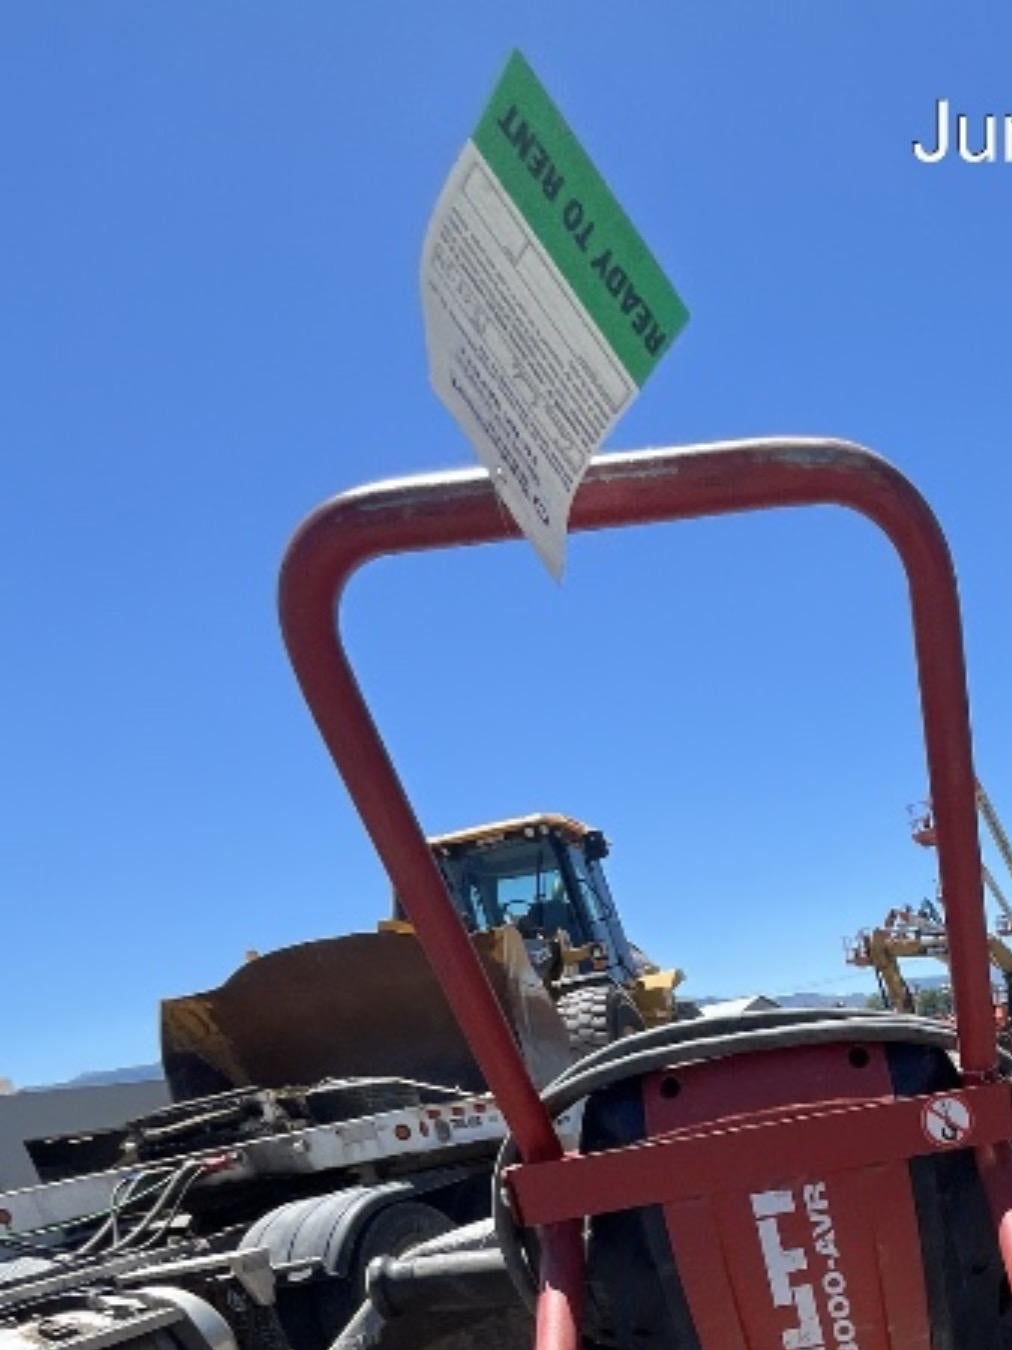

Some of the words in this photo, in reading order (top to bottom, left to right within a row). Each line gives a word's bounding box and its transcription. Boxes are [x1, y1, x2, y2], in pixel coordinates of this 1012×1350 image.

[497, 104, 565, 202] RENT
[563, 199, 595, 252] TO
[590, 250, 667, 358] READY
